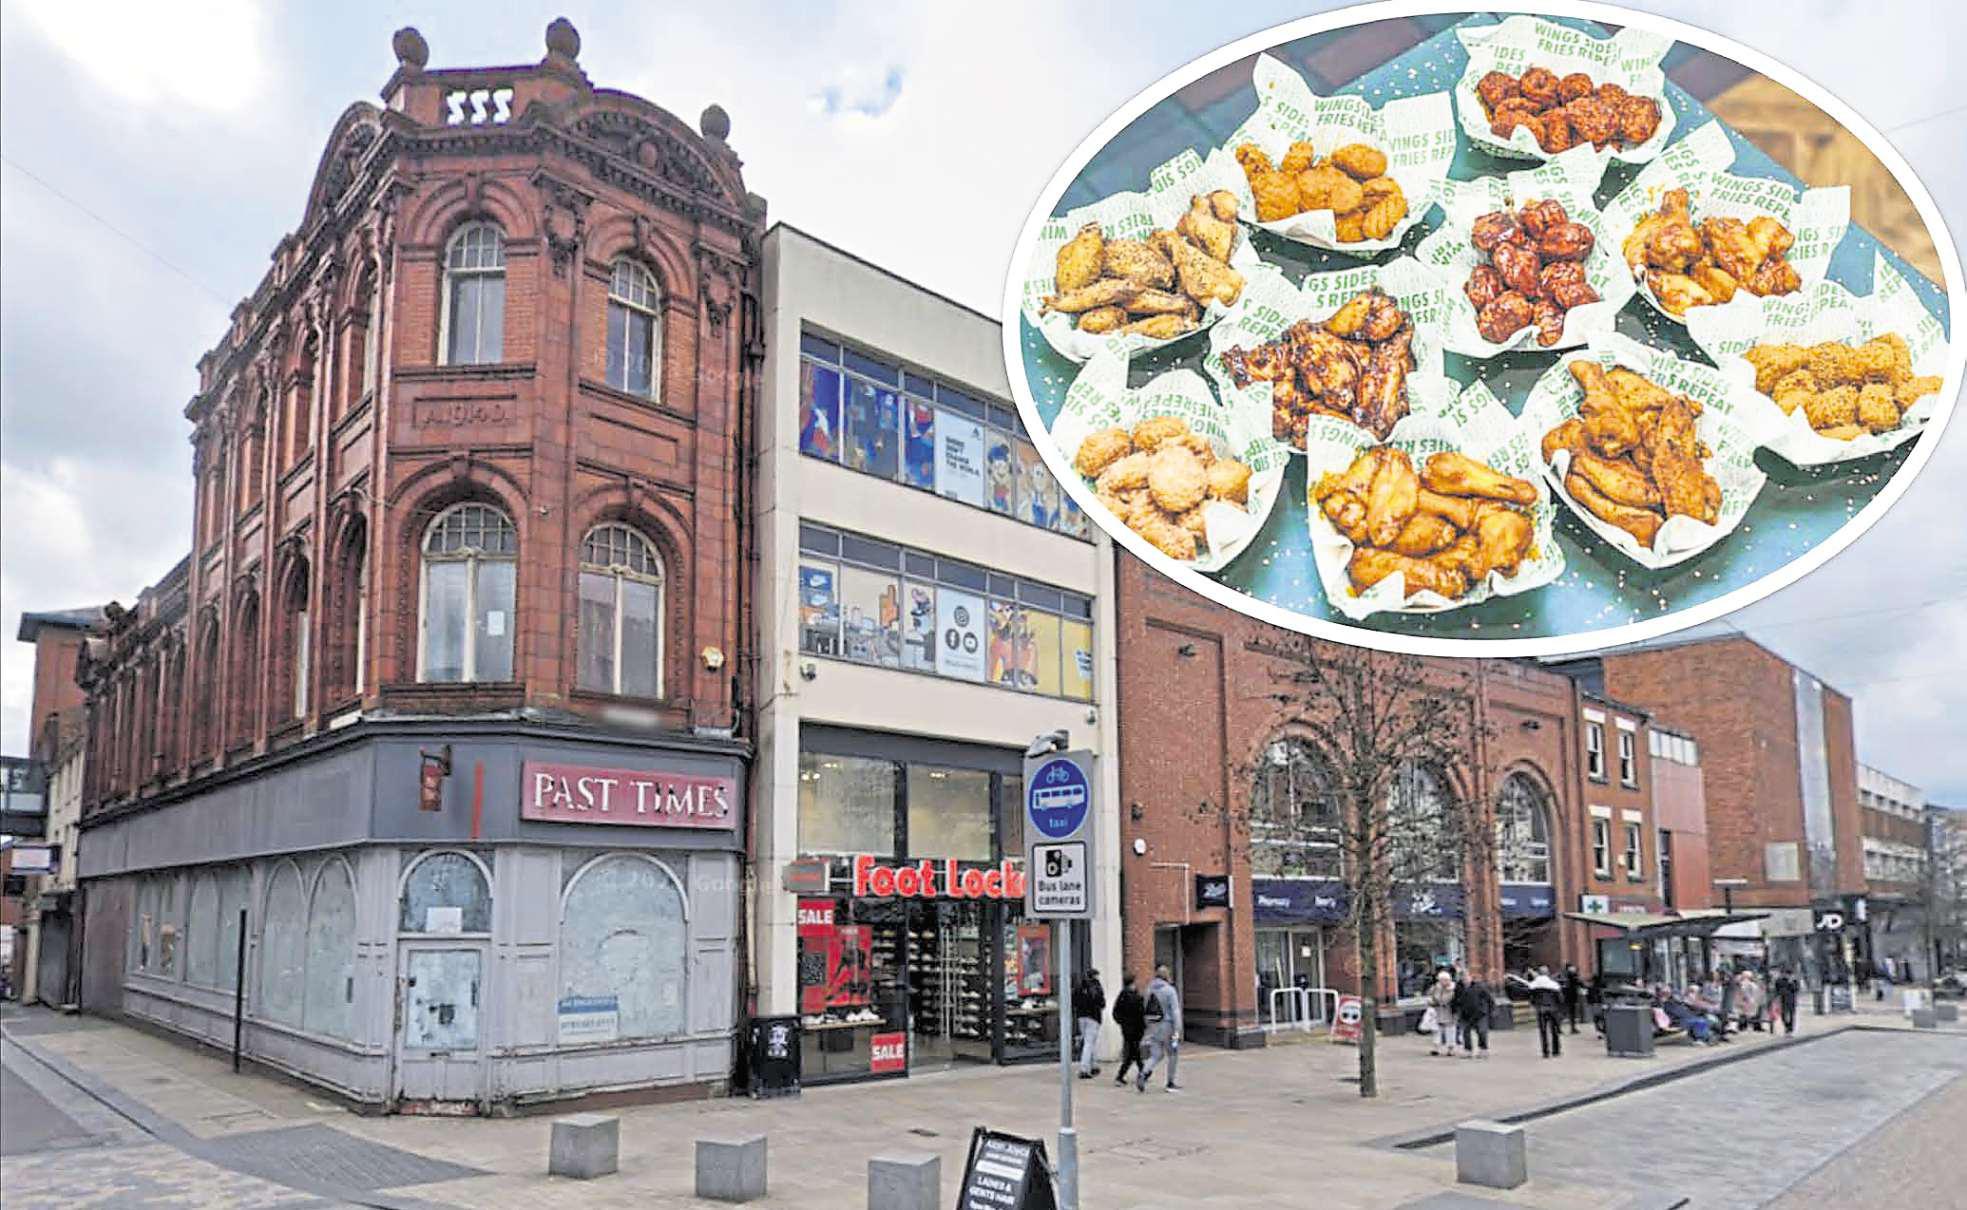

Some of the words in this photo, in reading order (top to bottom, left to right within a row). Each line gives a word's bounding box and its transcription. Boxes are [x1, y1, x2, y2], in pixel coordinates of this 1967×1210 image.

[1316, 113, 1354, 127] FRIES
[1711, 171, 1764, 192] WINGS
[1710, 187, 1754, 204] FRIES
[1334, 269, 1377, 290] SIDES
[1678, 378, 1735, 415] REPEAT
[533, 772, 617, 812] PAST
[630, 780, 729, 818] TIMES
[1049, 818, 1068, 829] taxi
[854, 853, 937, 898] Foot
[946, 857, 1026, 899] Lock
[1038, 881, 1056, 893] Bus
[1058, 879, 1082, 892] lane
[1038, 894, 1081, 906] cameras
[798, 908, 834, 926] SALE
[871, 1043, 905, 1060] SALE
